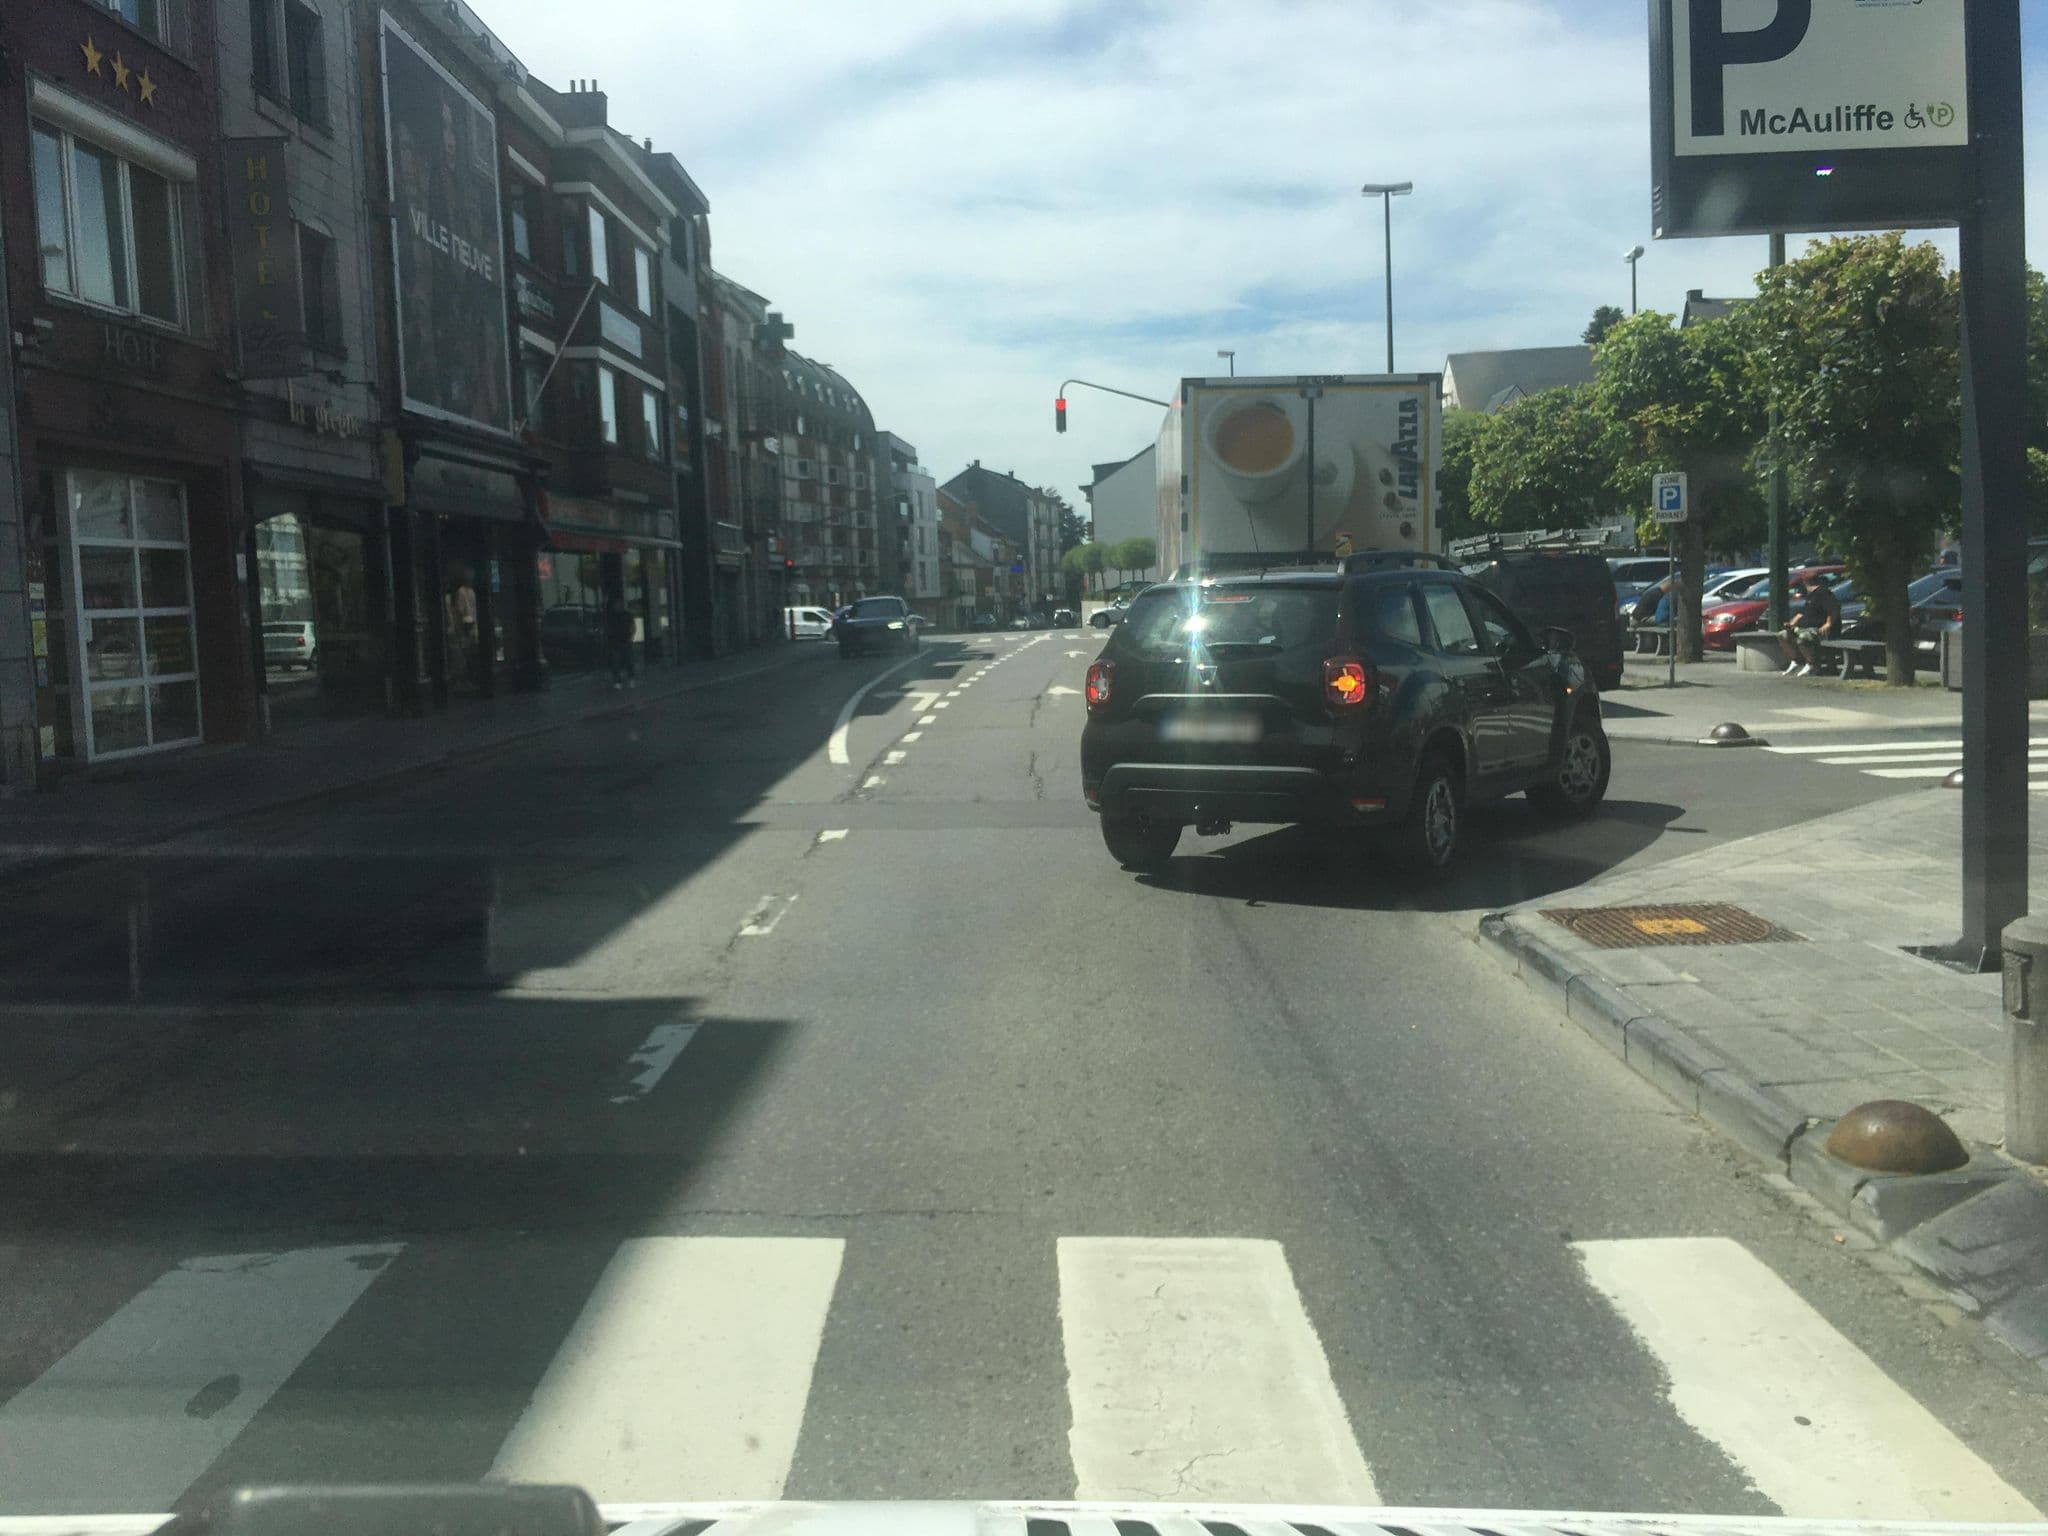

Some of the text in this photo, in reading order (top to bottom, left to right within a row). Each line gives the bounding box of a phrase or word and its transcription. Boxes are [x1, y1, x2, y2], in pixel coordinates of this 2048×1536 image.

[1689, 0, 1811, 136] P
[1740, 104, 1894, 135] McAuliffe
[1662, 487, 1678, 509] P
